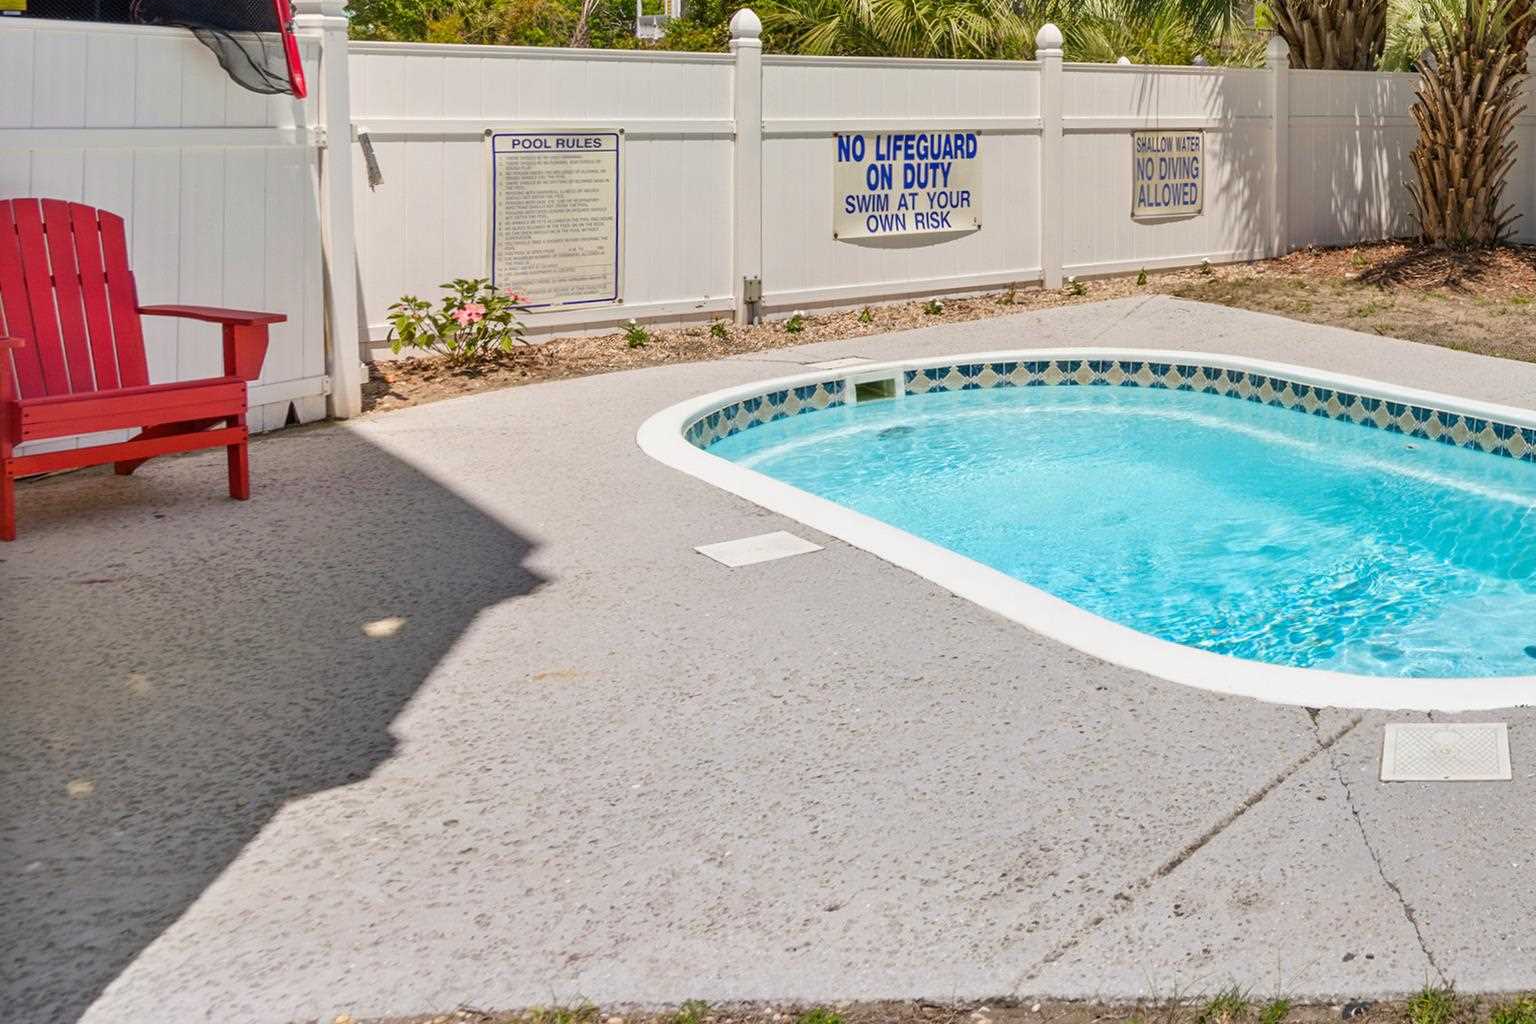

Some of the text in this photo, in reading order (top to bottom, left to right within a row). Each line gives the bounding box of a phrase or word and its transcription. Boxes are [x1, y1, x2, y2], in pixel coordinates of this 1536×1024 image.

[512, 137, 602, 149] POOL RULES
[838, 133, 977, 162] NO LIFEGUARD
[1136, 136, 1200, 153] SHALLOW WATER
[866, 162, 952, 191] ON DUTY
[1136, 156, 1199, 181] NO DIVING
[845, 190, 971, 214] SWIM AT YOUR
[1138, 182, 1198, 208] ALLOWED
[866, 213, 906, 233] OWN
[914, 211, 951, 230] RISK
